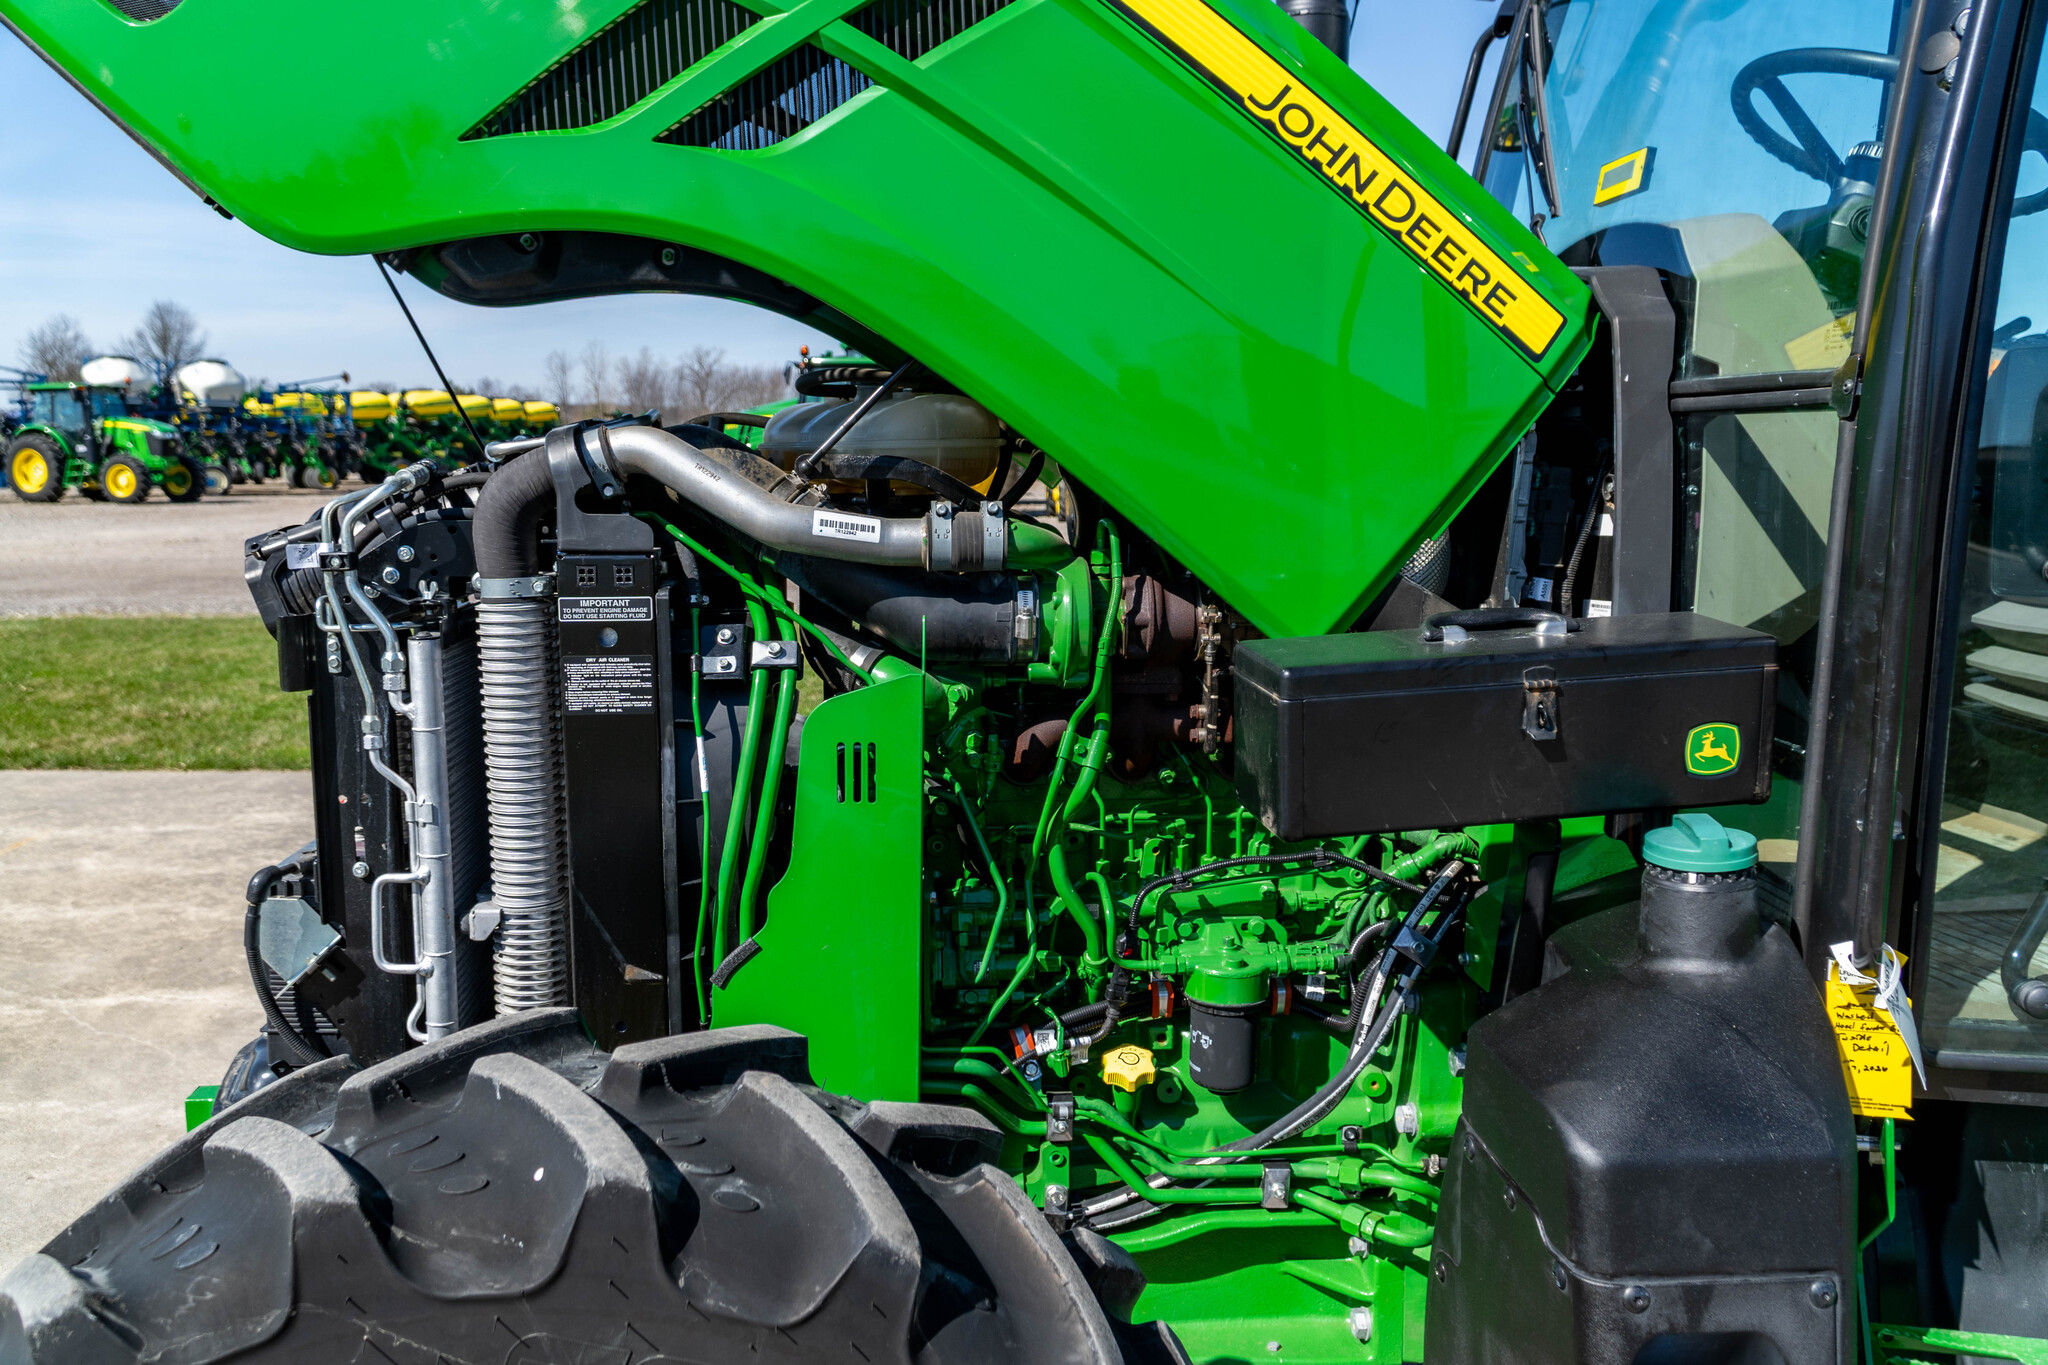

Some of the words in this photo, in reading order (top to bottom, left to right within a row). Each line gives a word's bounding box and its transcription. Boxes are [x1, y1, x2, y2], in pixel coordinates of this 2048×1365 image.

[1247, 84, 1378, 195] JOHN
[1372, 178, 1518, 320] DEERE
[1540, 580, 1549, 598] A5501
[579, 599, 631, 607] IMPORTANT
